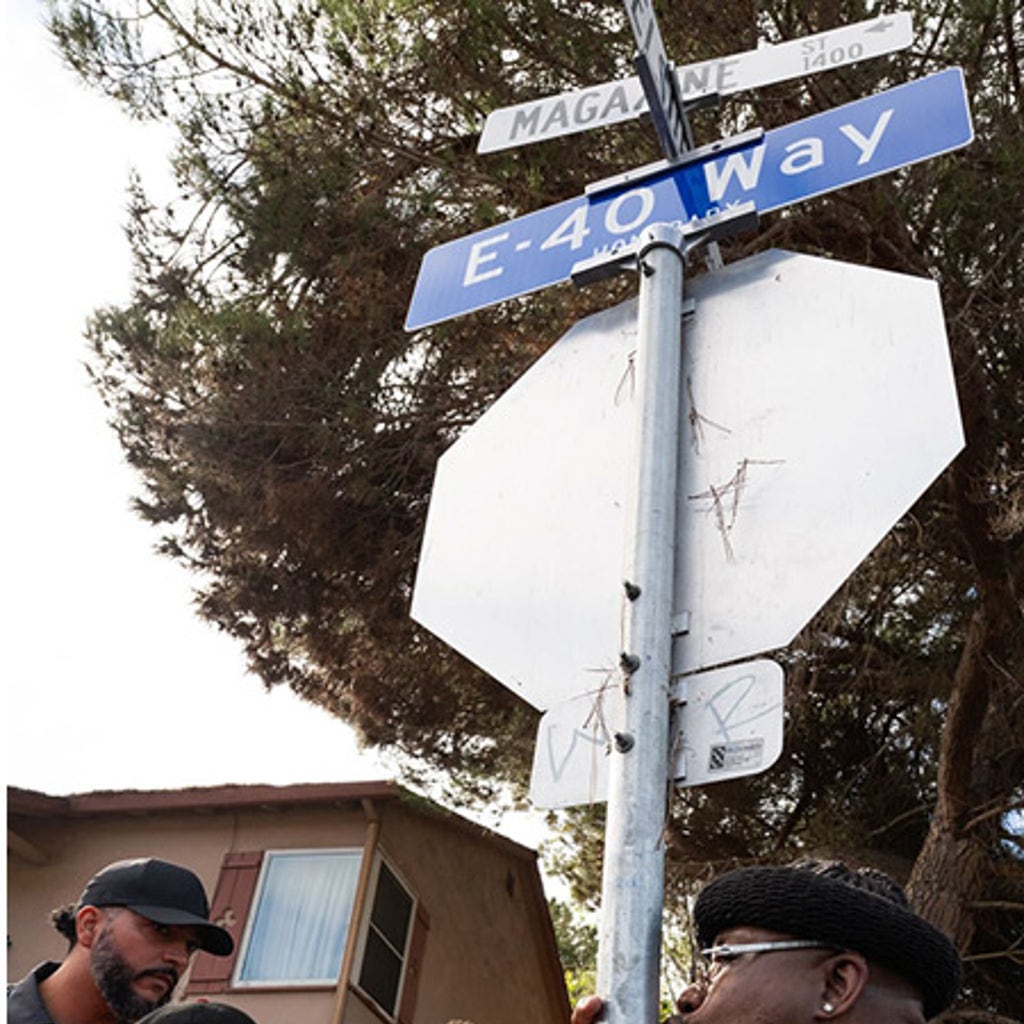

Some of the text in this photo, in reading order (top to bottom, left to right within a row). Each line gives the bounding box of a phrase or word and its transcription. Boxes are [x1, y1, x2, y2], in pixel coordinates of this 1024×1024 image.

[802, 36, 829, 55] ST
[803, 42, 864, 71] 1400
[462, 108, 895, 288] E-40 Way
